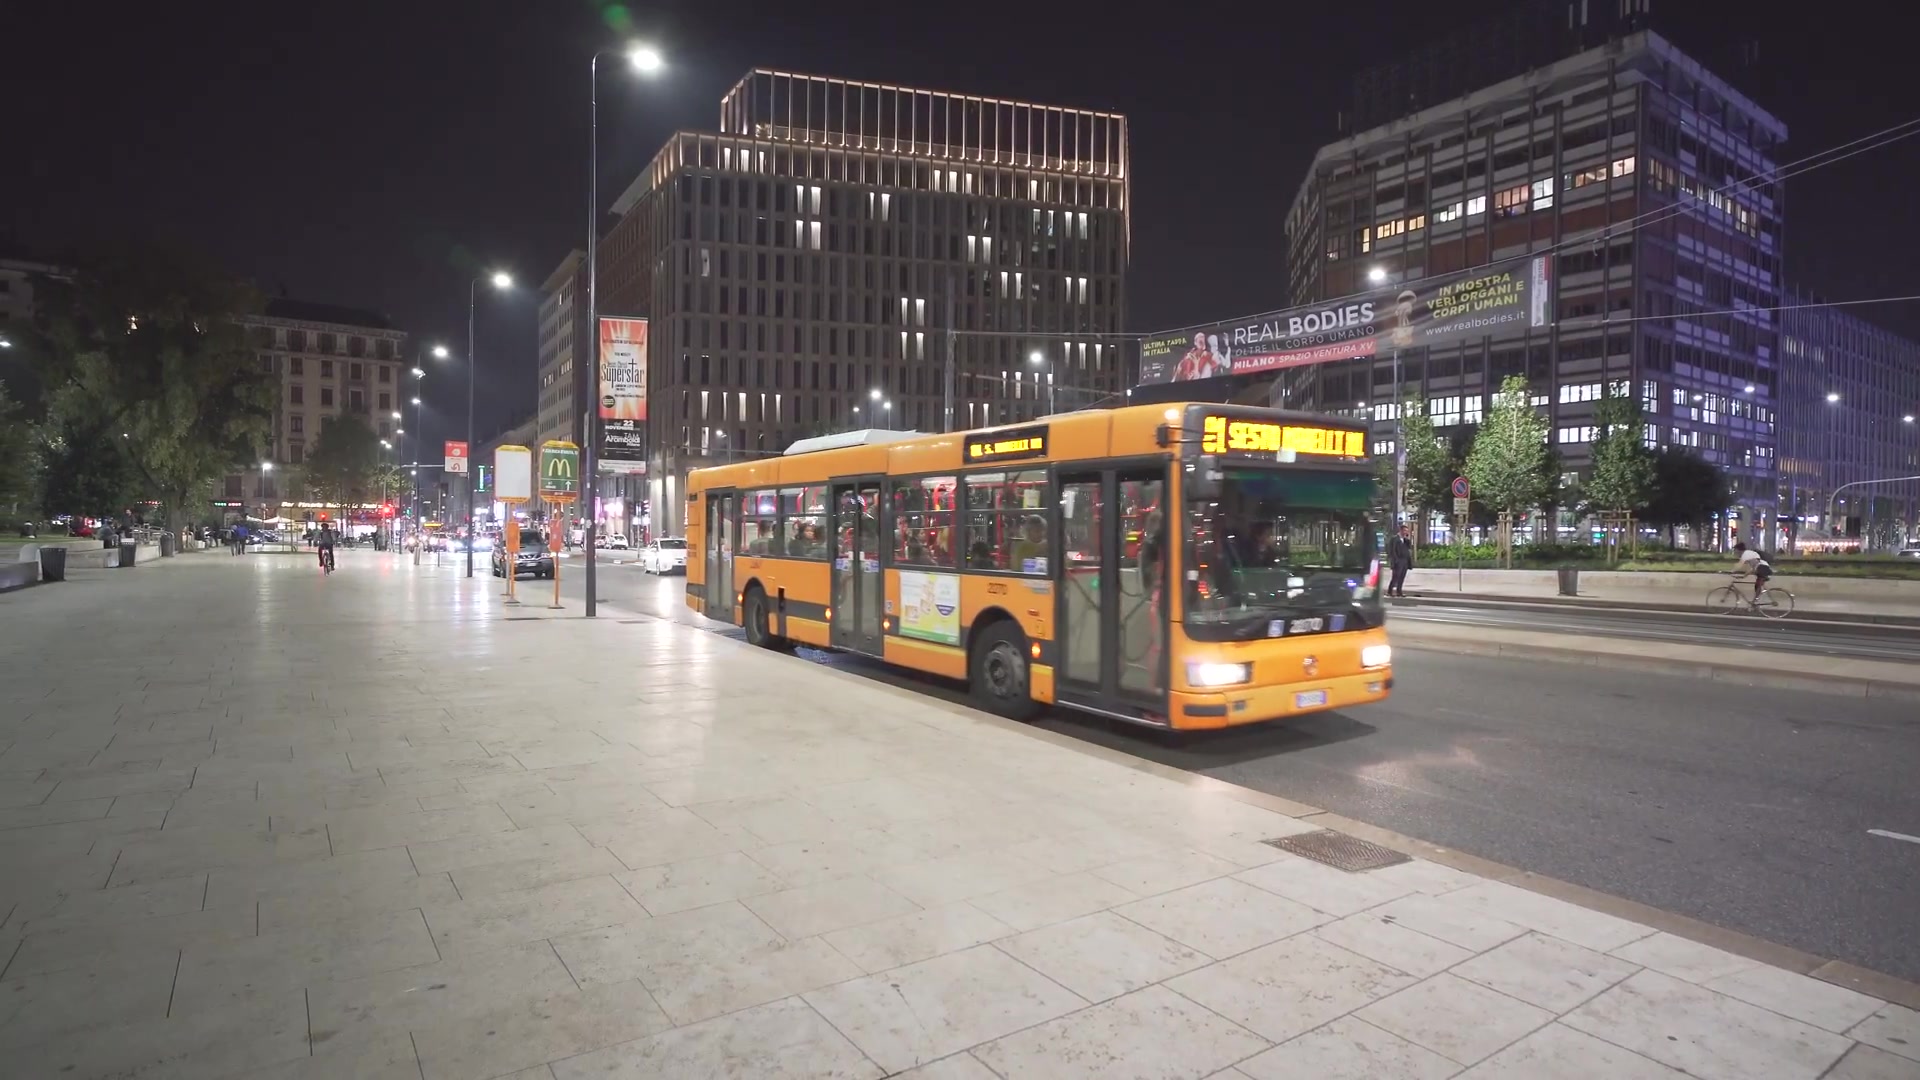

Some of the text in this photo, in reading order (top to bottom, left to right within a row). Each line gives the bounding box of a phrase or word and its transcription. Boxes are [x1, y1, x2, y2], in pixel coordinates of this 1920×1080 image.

[1426, 280, 1524, 310] VERI ORGANI E
[1438, 272, 1511, 297] IN MOSTRA
[1432, 294, 1518, 319] CORPI UMANI
[1234, 302, 1375, 346] REAL BODIES
[1425, 311, 1525, 336] www.realbodies.it
[1143, 337, 1188, 350] ULTIMA TAPPA
[1151, 347, 1171, 356] ITALIA
[1235, 326, 1375, 357] OLTRE IL CORPO UMANO
[1234, 342, 1374, 370] MILANO SPAZIO VENTURA XV
[601, 358, 645, 389] Superstar
